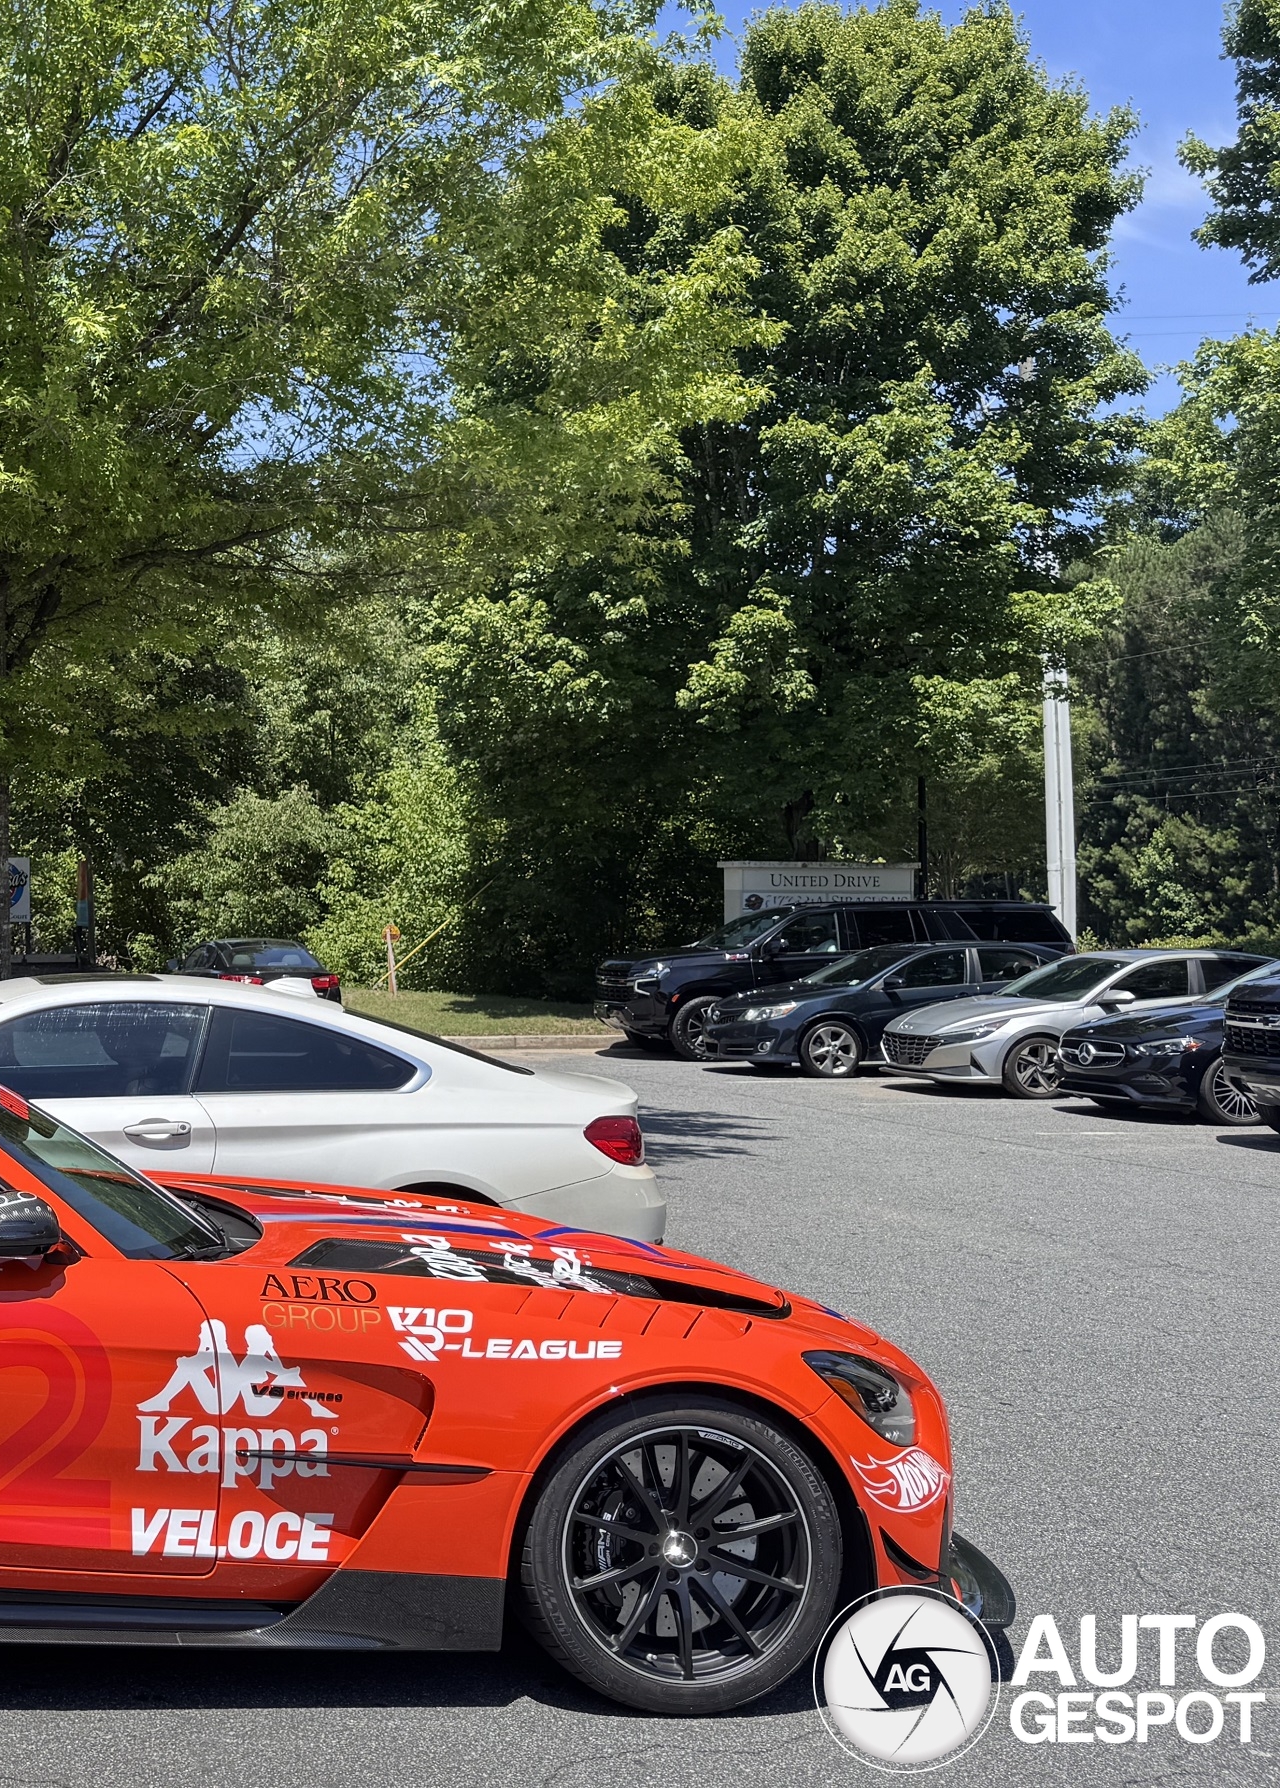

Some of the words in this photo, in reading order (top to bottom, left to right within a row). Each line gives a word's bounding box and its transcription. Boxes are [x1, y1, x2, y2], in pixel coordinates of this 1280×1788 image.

[769, 873, 829, 888] UNITED
[834, 873, 881, 888] DRIVE
[259, 1273, 378, 1304] AERO
[262, 1302, 382, 1334] GROUP
[250, 1383, 285, 1398] V8
[287, 1391, 344, 1403] BITURBO
[135, 1415, 332, 1490] Kappa
[774, 1438, 823, 1499] MICHELIN
[131, 1507, 335, 1561] VELOCE
